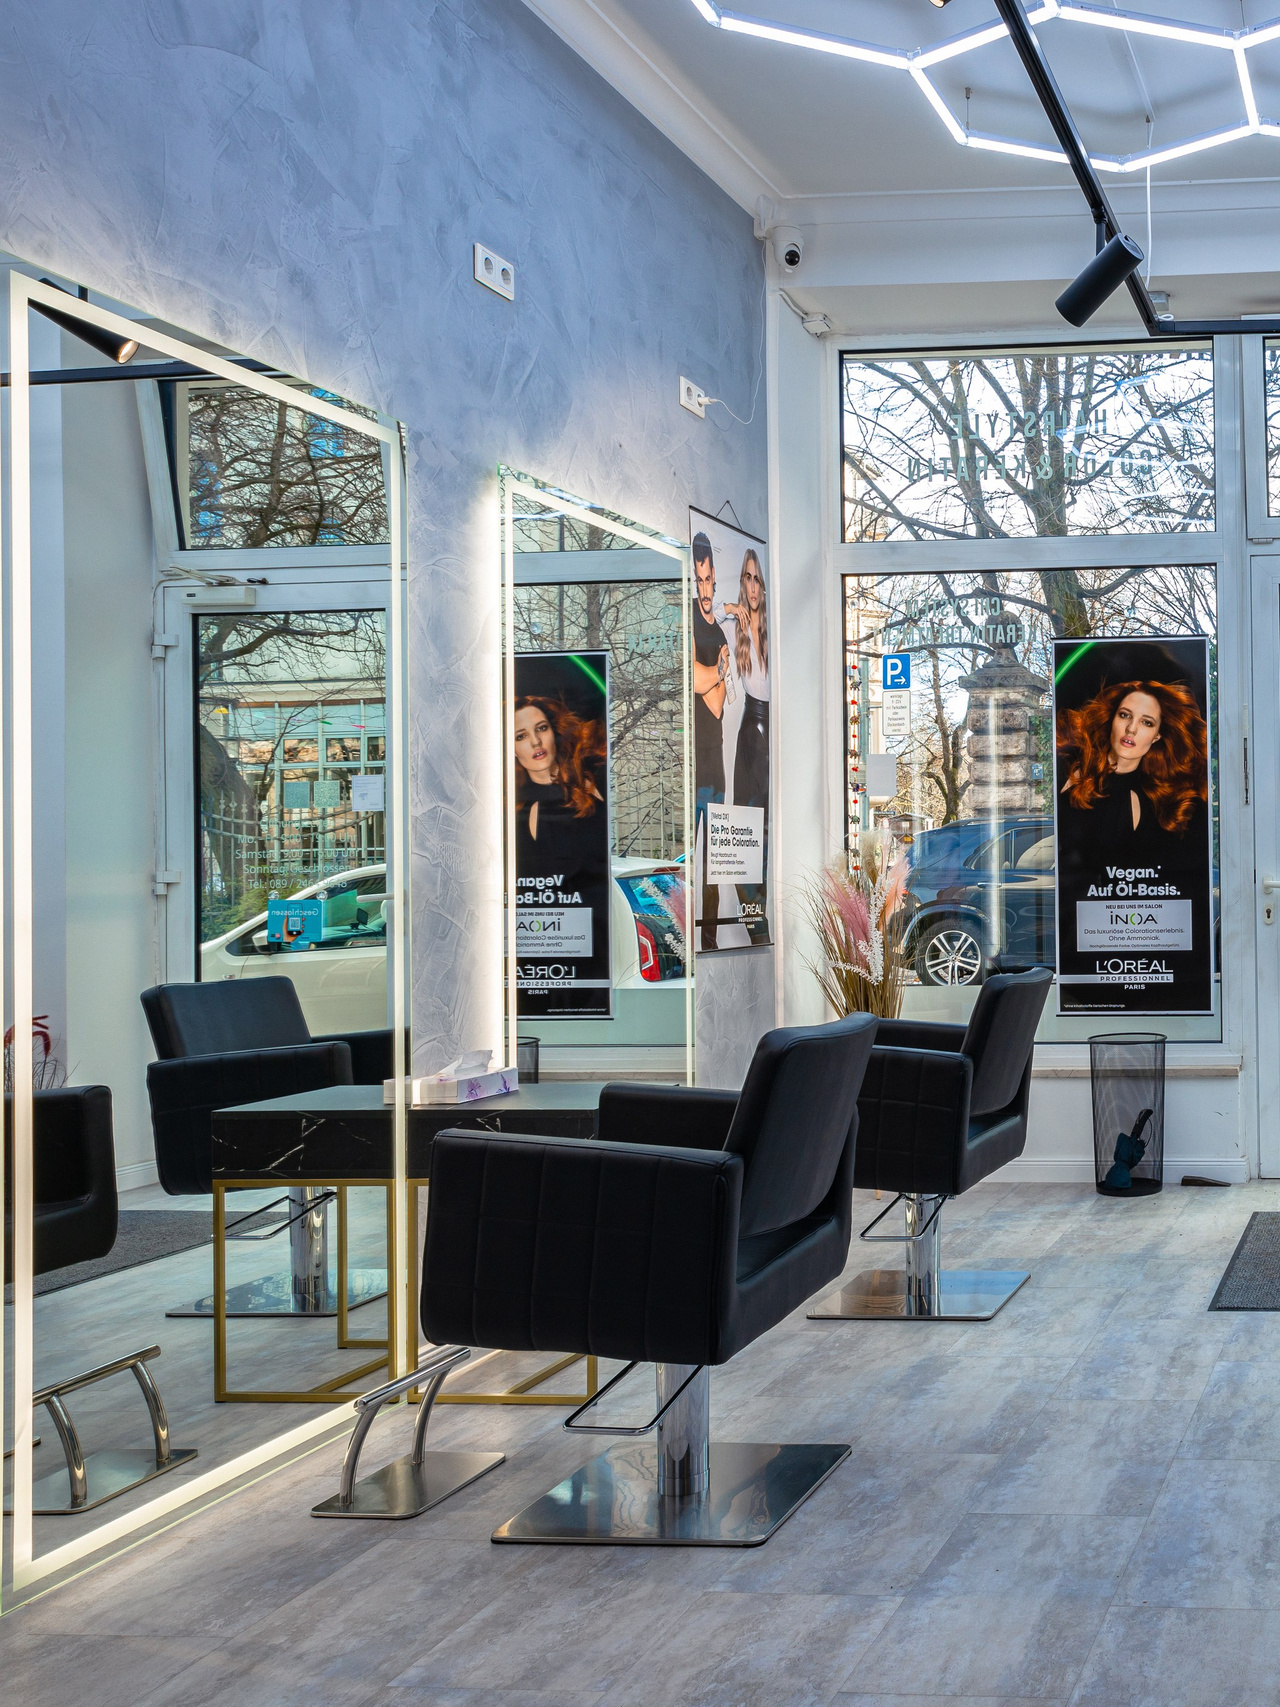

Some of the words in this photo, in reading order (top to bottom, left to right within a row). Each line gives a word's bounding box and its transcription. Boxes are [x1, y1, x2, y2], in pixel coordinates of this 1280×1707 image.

[887, 658, 902, 686] P
[711, 824, 719, 834] Die
[721, 825, 729, 835] Pro
[731, 826, 753, 836] Garantie
[719, 837, 731, 848] jede
[732, 837, 760, 848] Coloration.
[270, 879, 287, 889] 089
[1087, 884, 1113, 897] Auf
[1116, 881, 1180, 896] Öl-Basis.
[1096, 958, 1174, 974] L'ORÉAL
